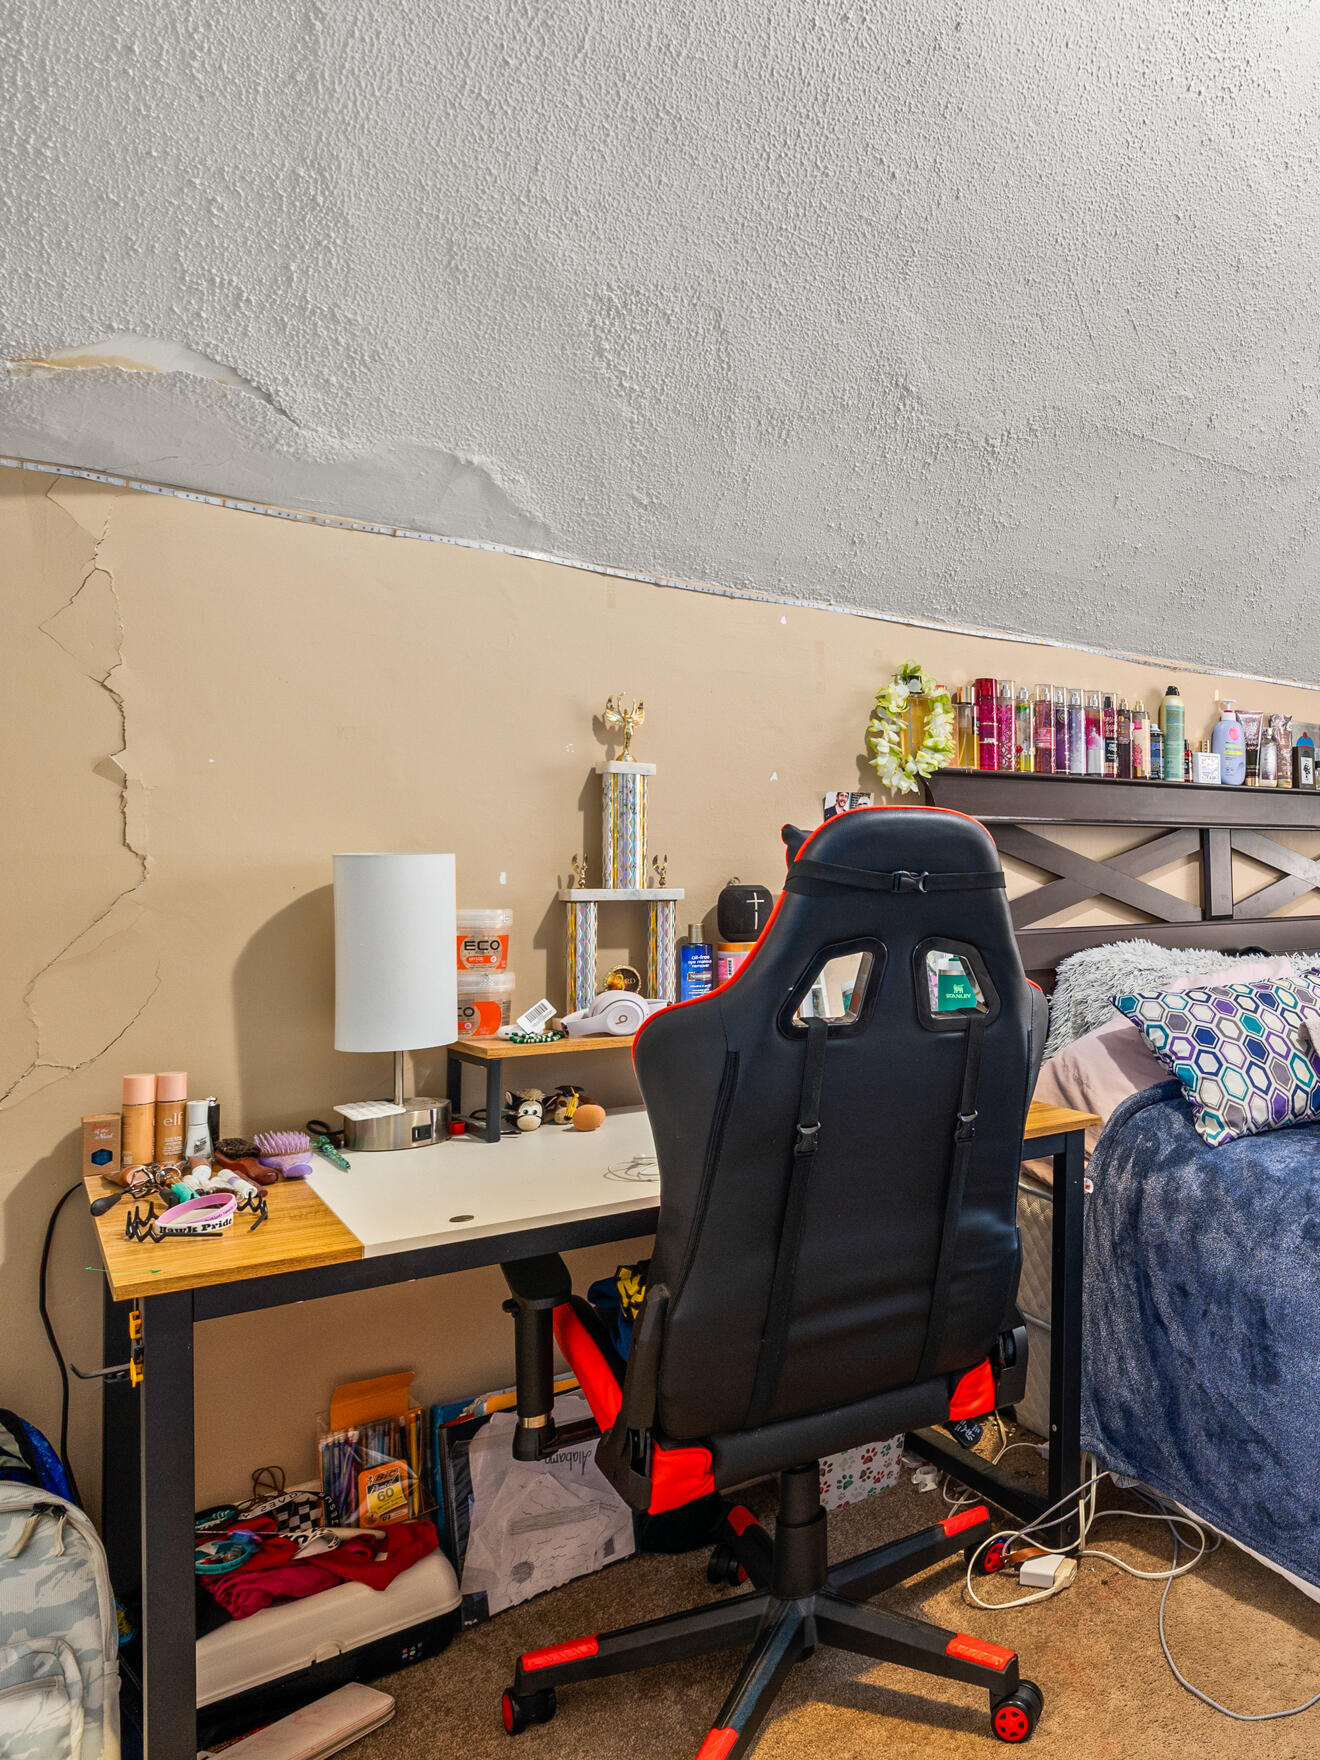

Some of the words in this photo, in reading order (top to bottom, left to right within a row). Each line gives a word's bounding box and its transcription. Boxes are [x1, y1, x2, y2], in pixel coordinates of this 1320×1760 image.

[464, 940, 500, 951] ECO
[160, 1224, 198, 1234] Hawk
[201, 1217, 232, 1232] Pride
[377, 1487, 394, 1502] 60
